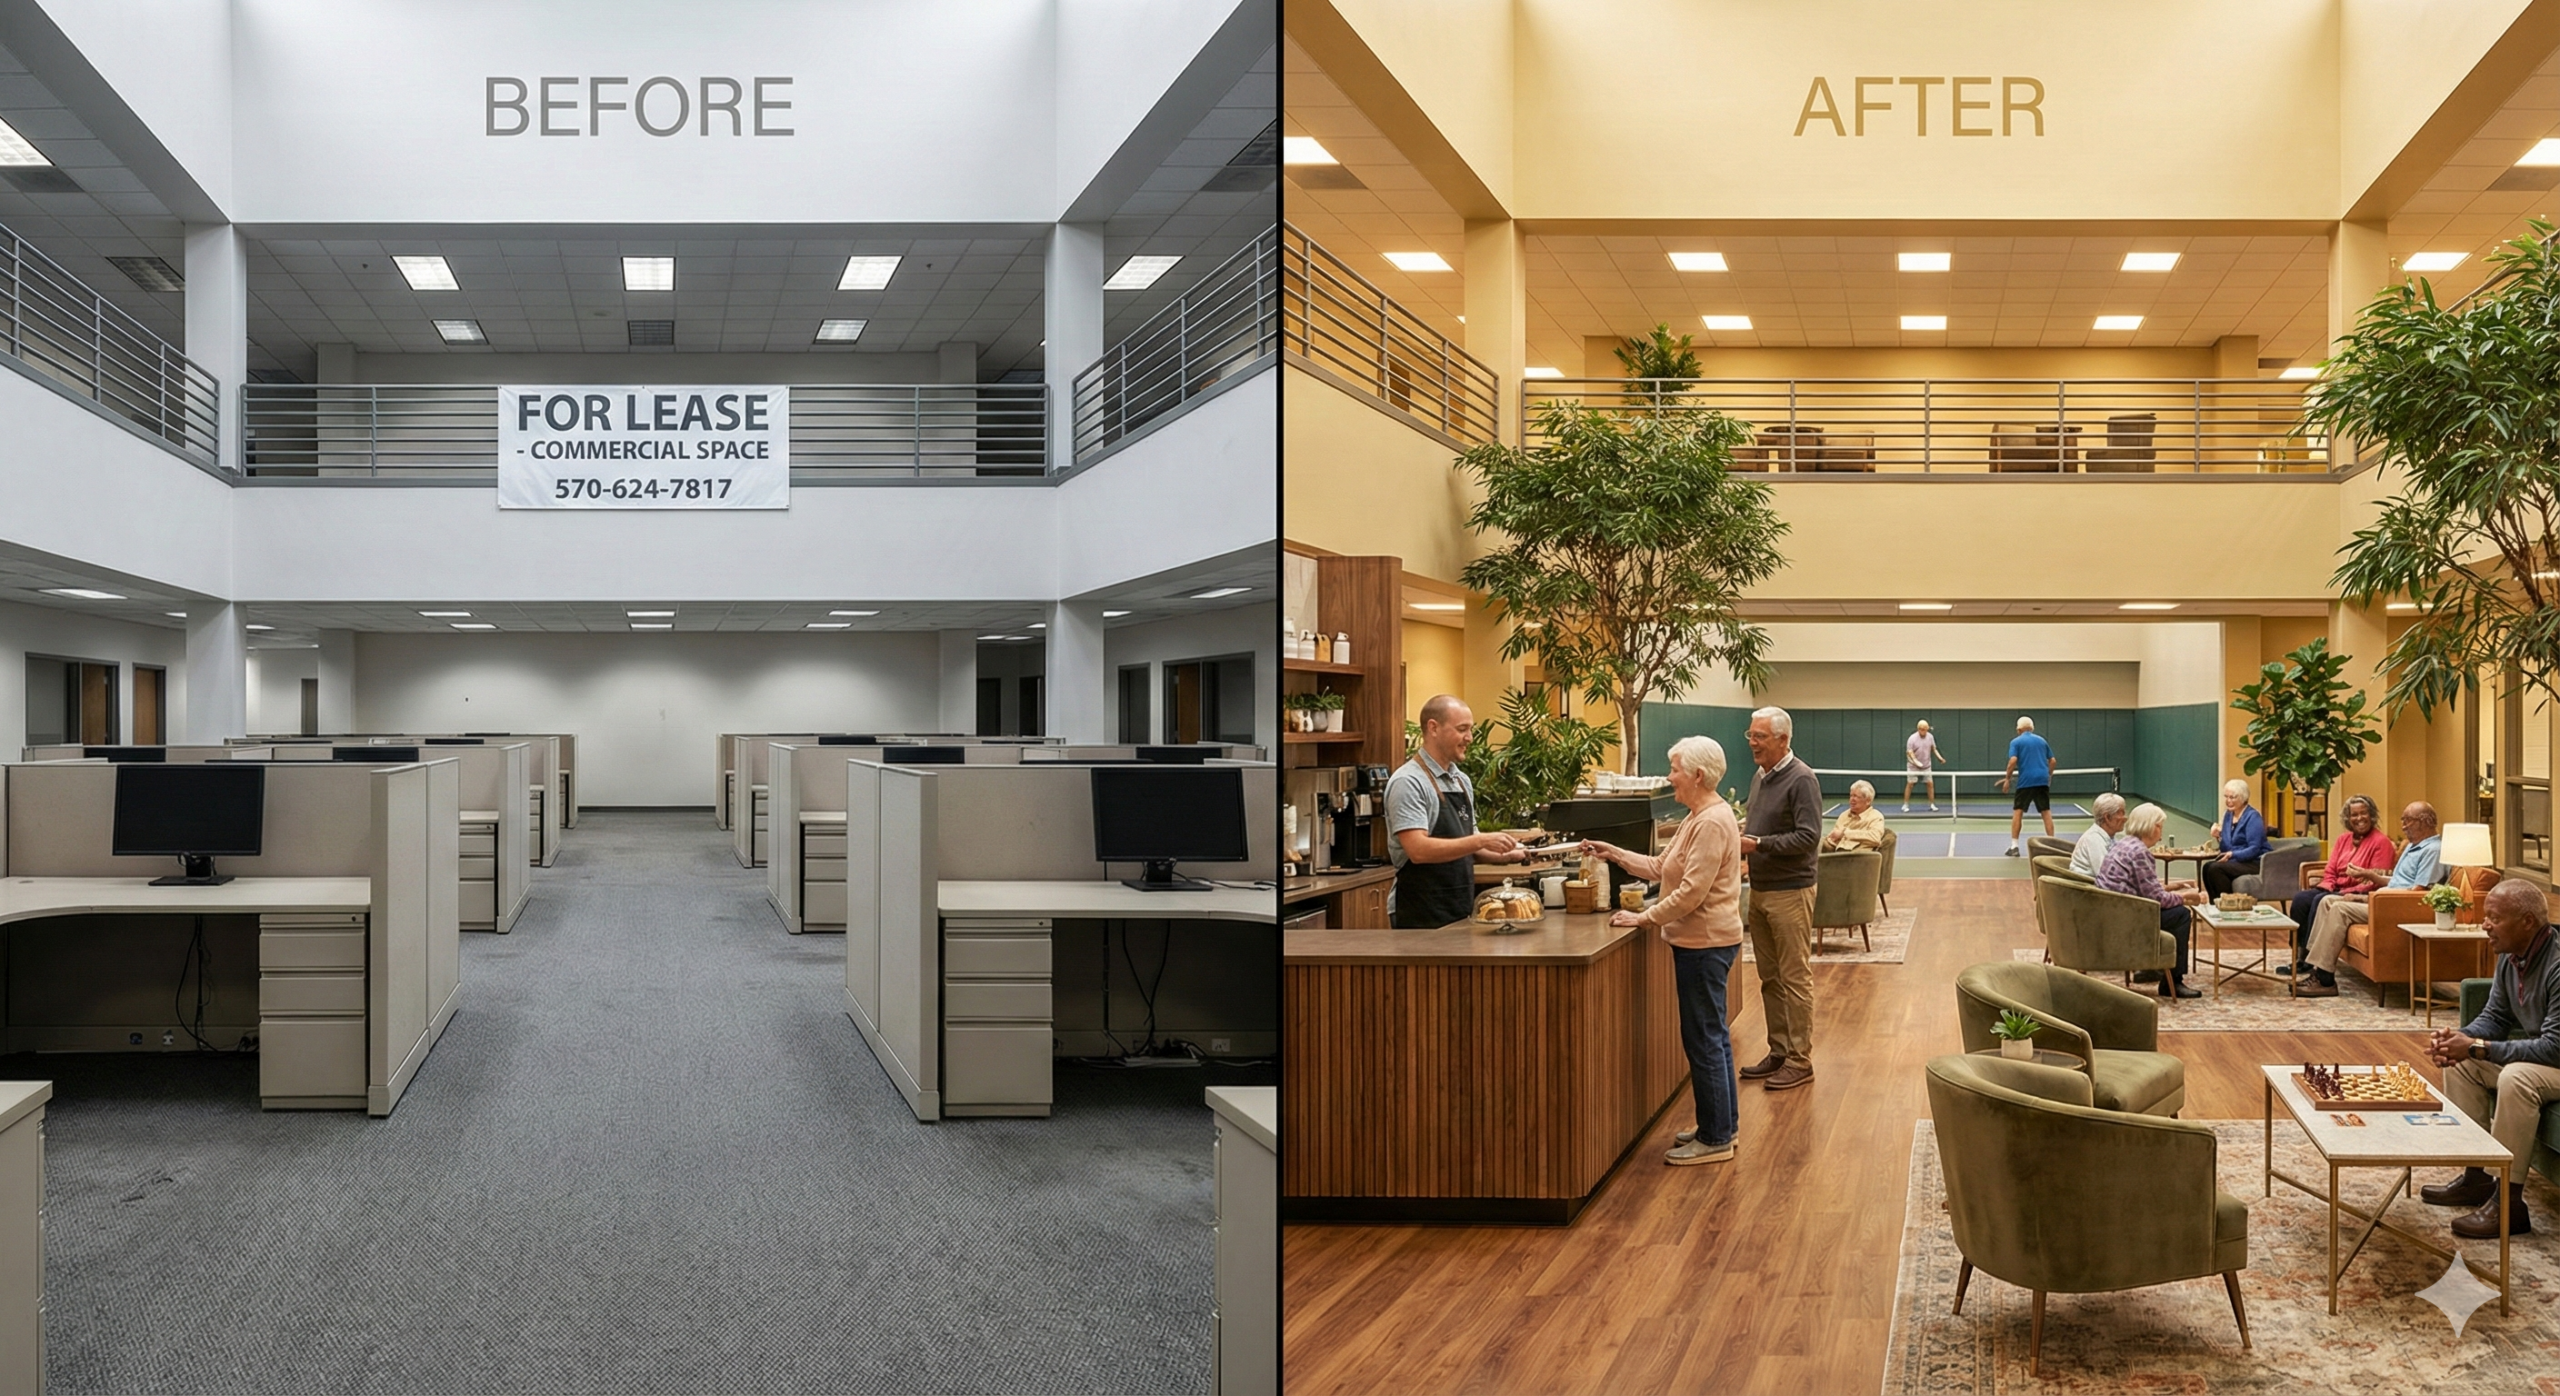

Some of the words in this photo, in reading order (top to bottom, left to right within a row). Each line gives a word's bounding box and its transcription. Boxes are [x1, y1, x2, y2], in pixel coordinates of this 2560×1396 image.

[518, 394, 612, 432] FOR
[626, 394, 769, 432] LEASE
[530, 440, 691, 460] COMMERCIAL
[696, 440, 769, 460] SPACE
[555, 478, 733, 499] 570-624-7817
